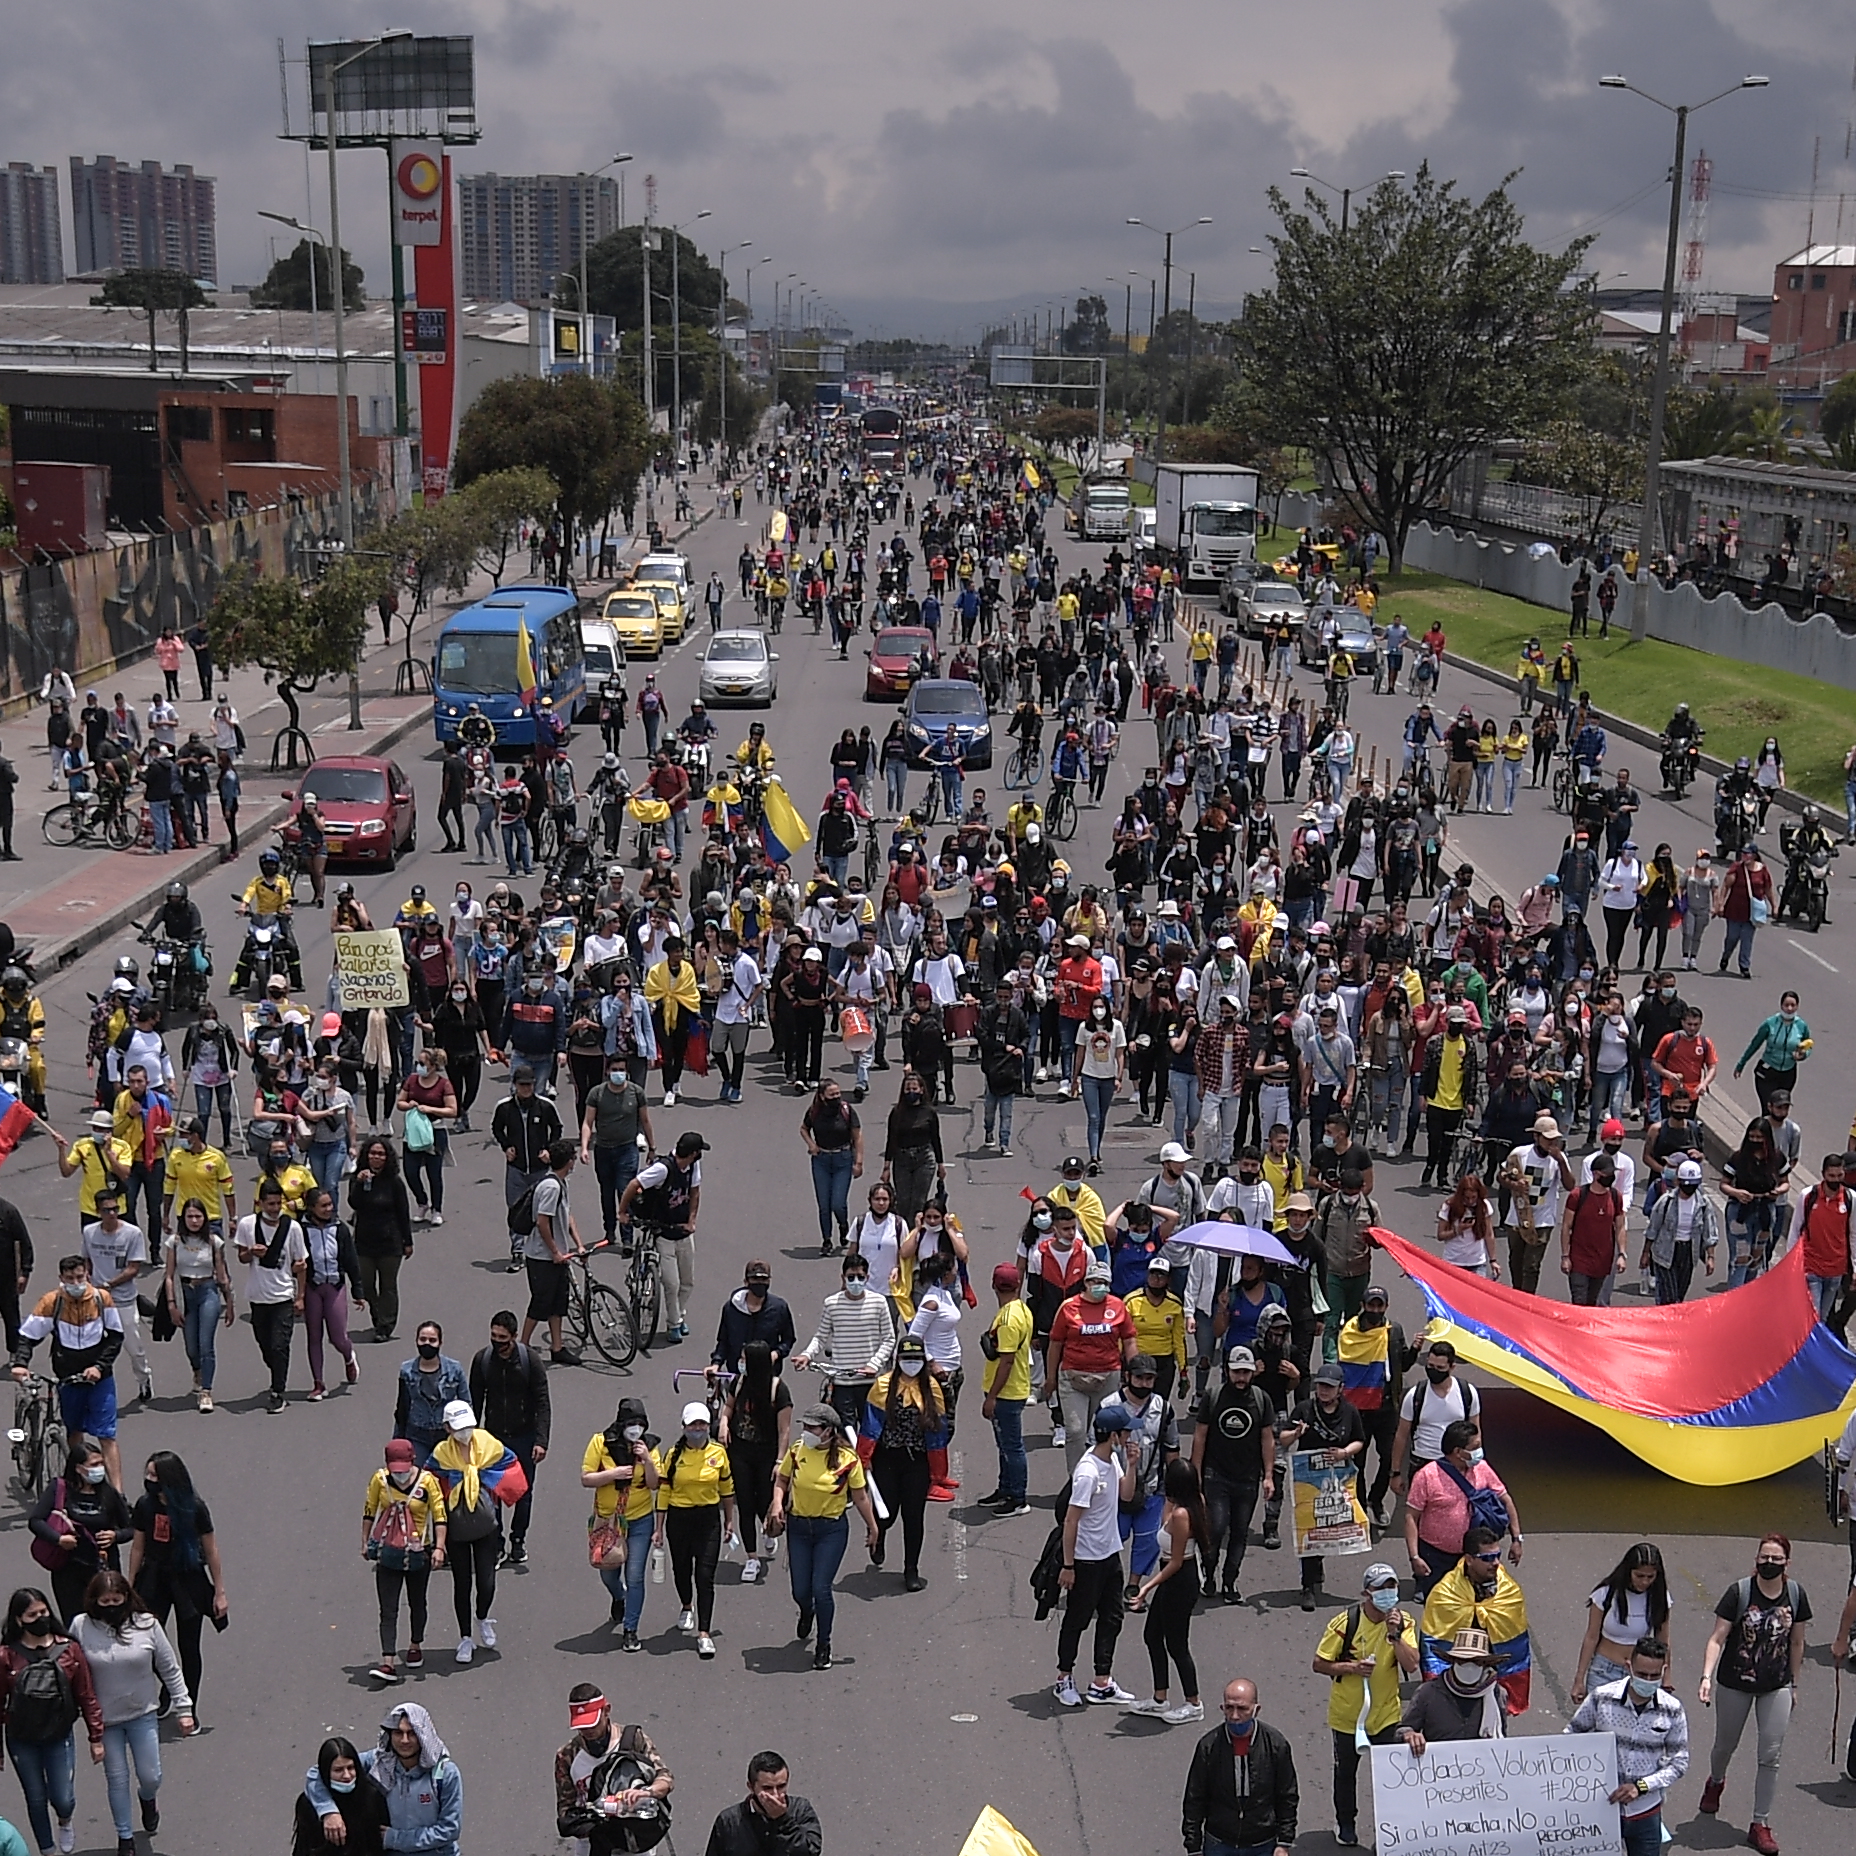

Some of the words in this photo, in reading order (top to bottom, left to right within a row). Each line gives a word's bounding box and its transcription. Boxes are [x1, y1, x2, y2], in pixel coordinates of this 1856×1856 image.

[402, 209, 439, 224] terpel
[1383, 1750, 1486, 1790] Soldados
[1490, 1744, 1607, 1780] Voluntarios
[1539, 1775, 1611, 1804] #28A
